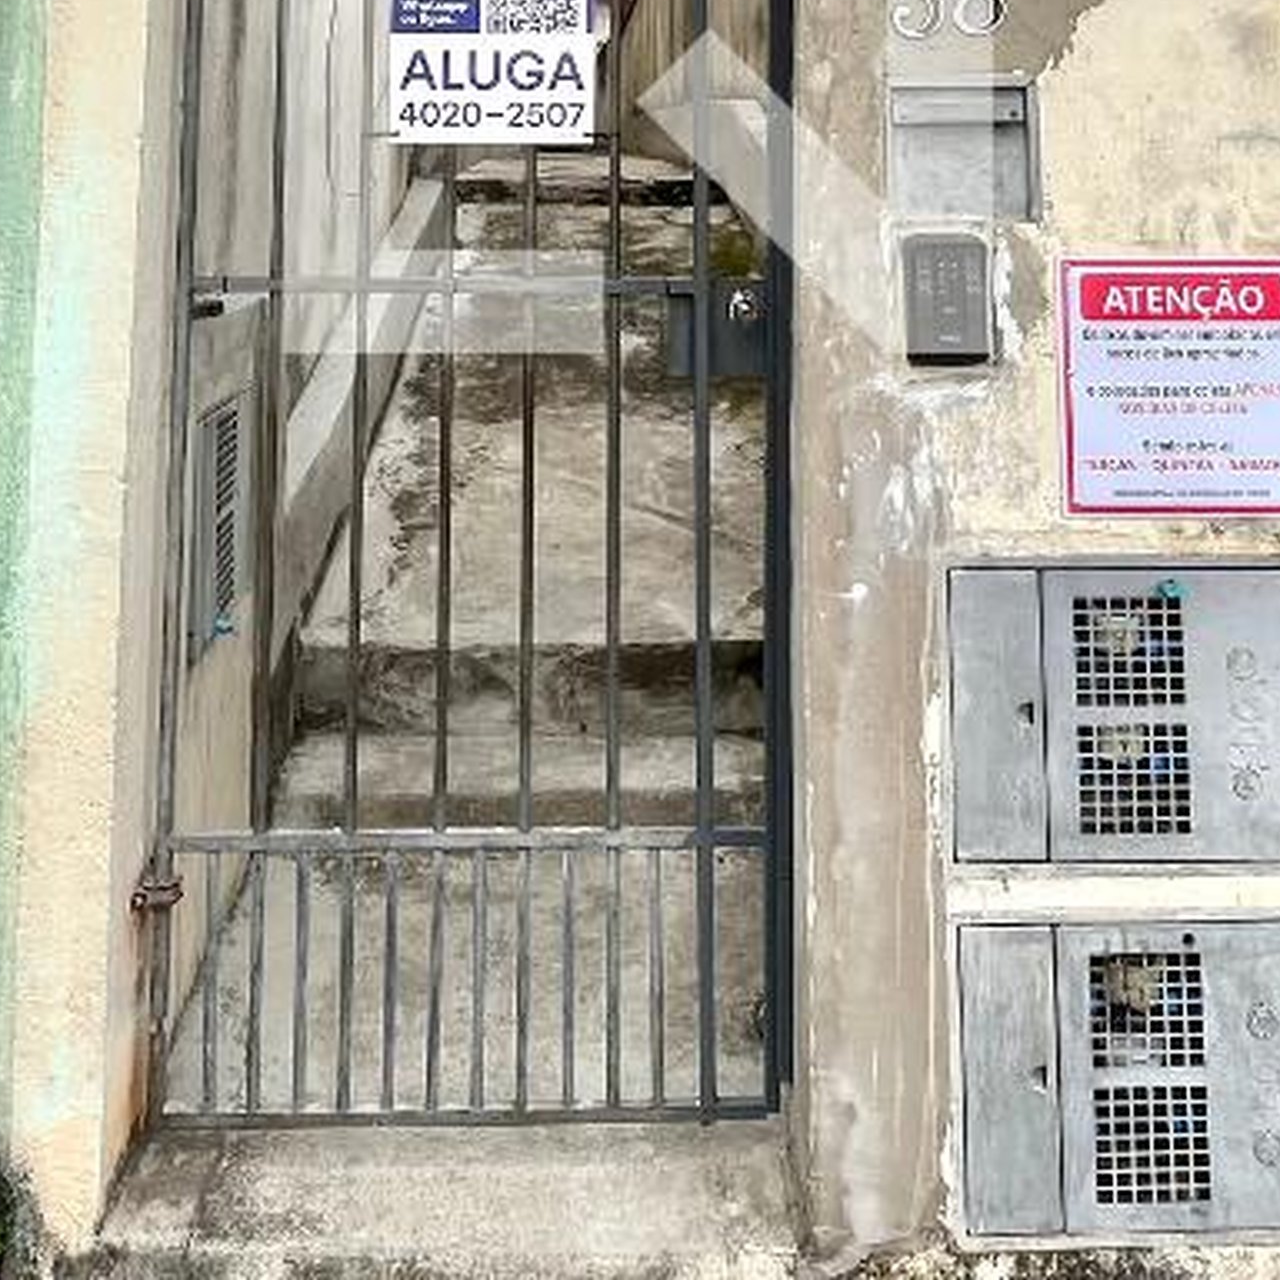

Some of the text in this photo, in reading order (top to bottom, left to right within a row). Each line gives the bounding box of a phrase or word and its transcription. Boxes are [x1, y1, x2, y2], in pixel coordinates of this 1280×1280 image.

[400, 50, 585, 90] ALUGA
[399, 102, 585, 128] 4020-2507
[1103, 279, 1265, 322] ATENÇÃO
